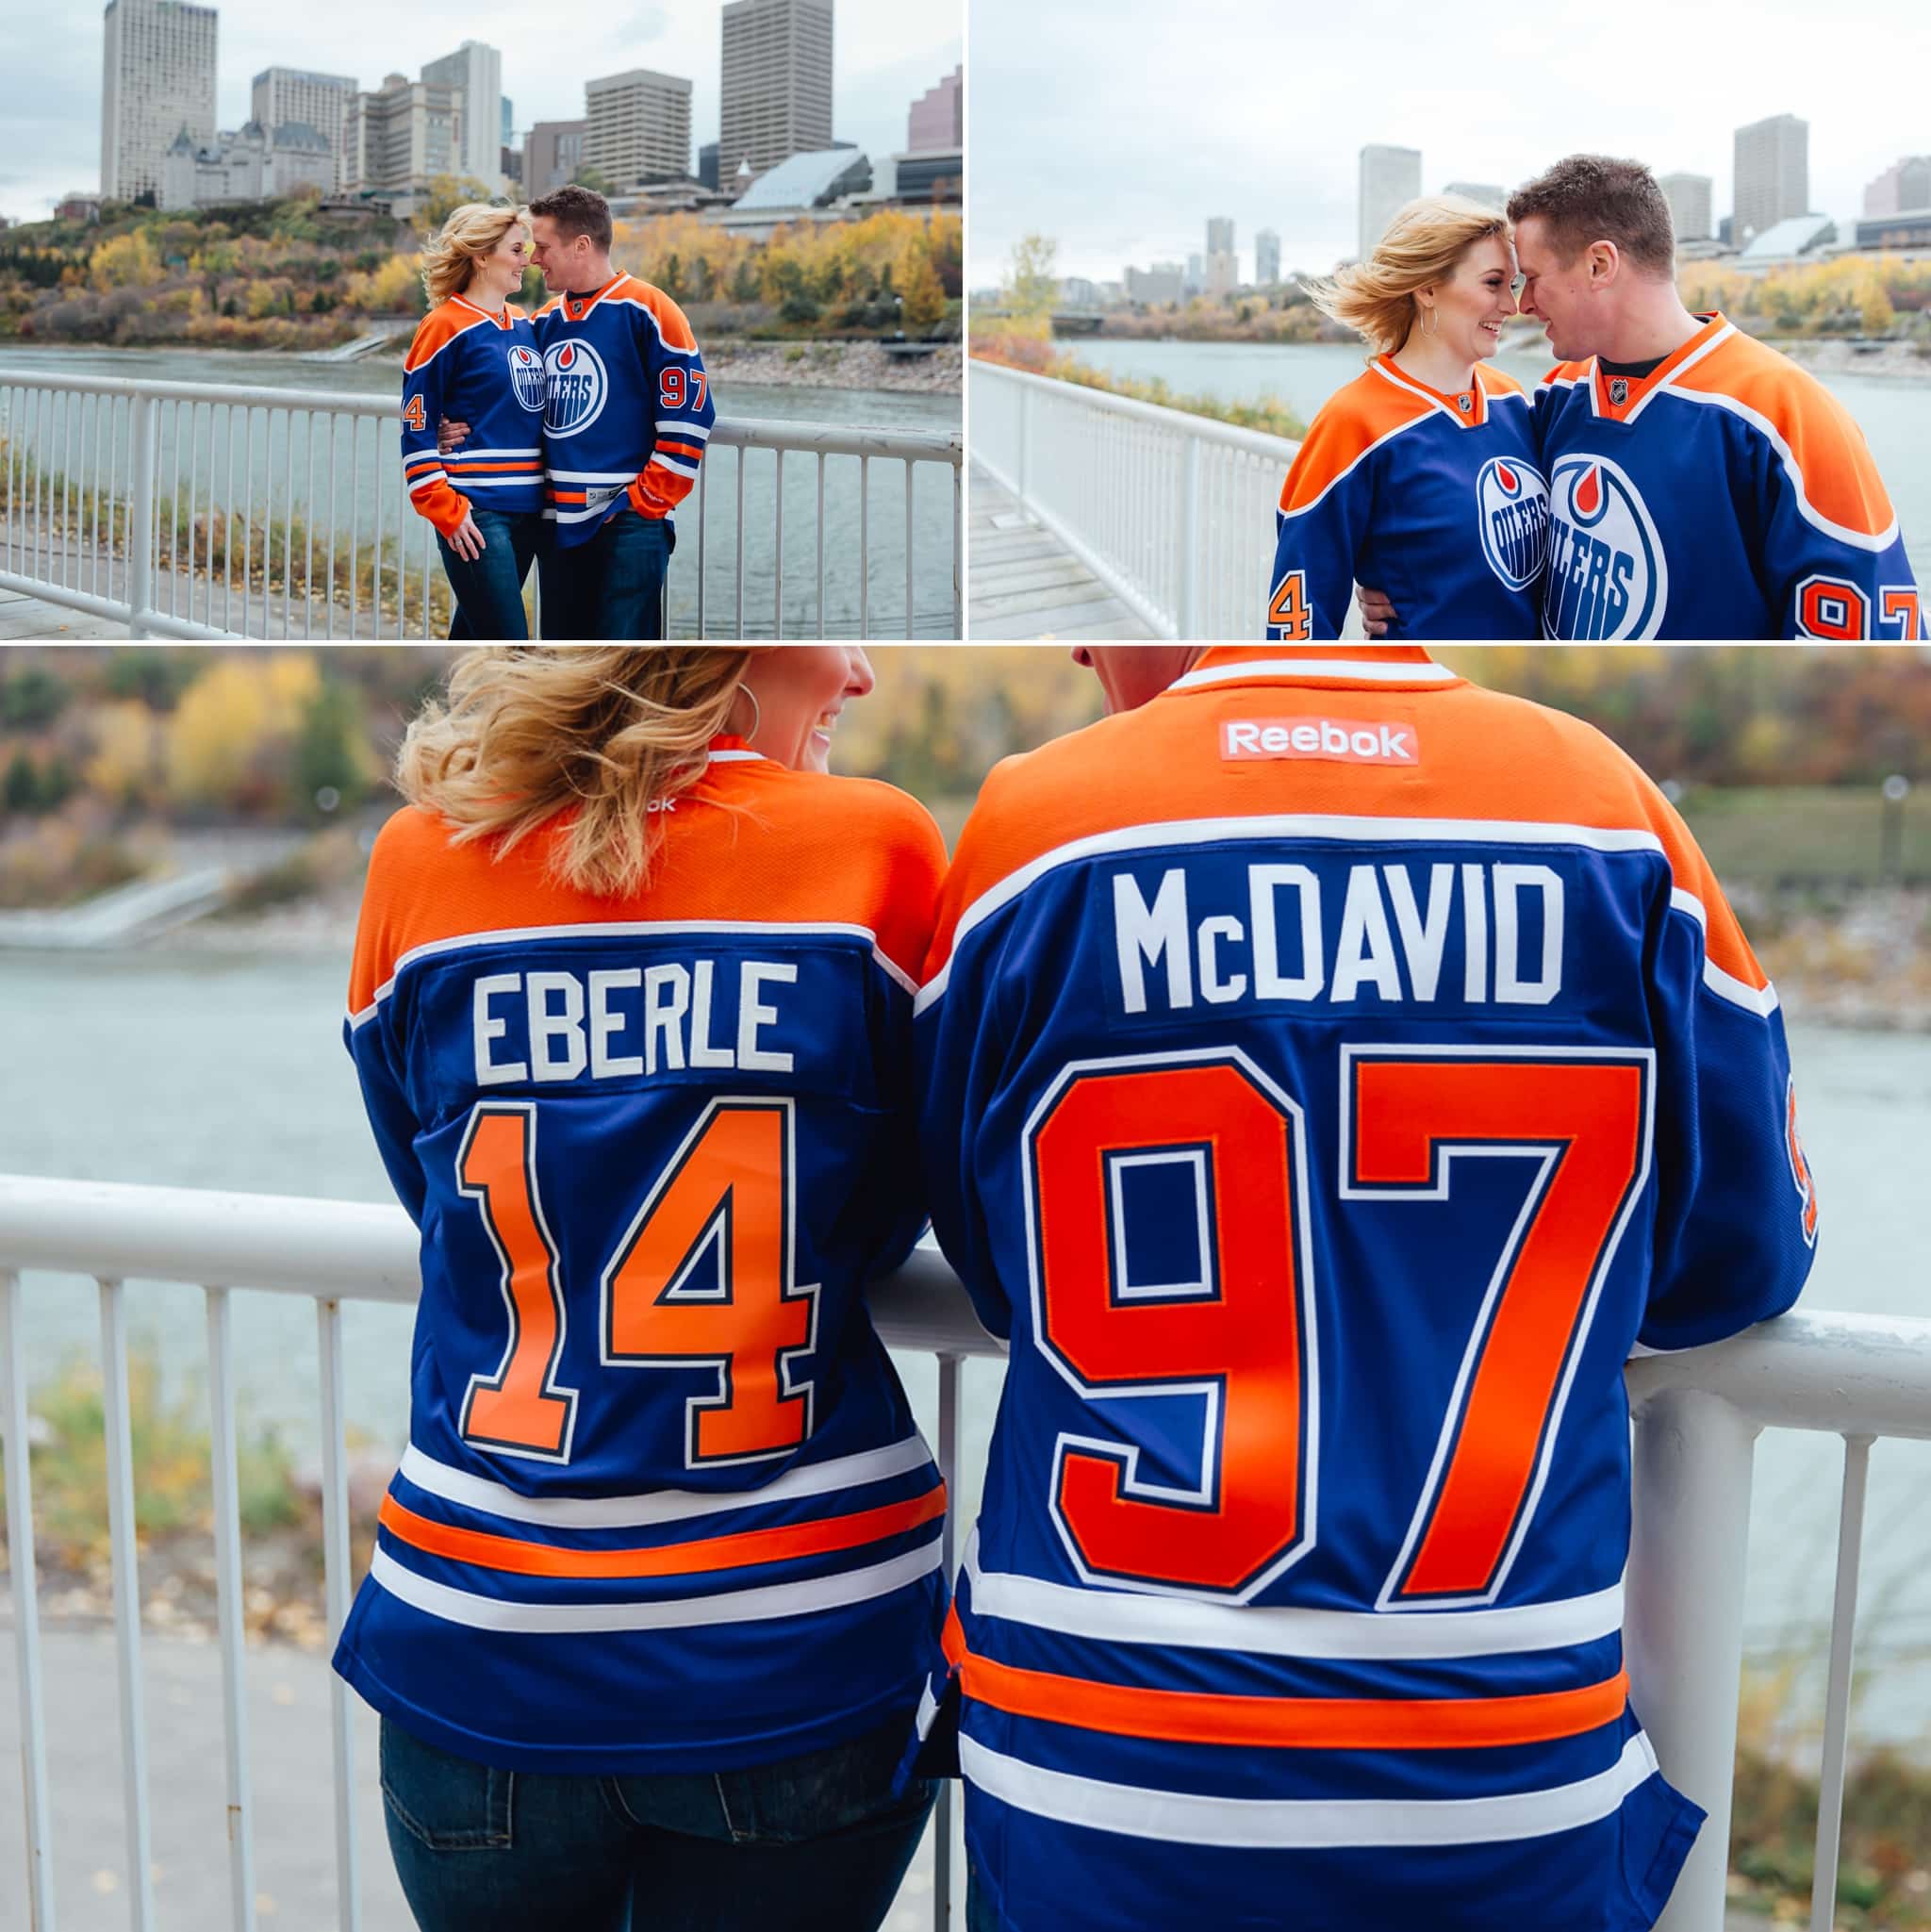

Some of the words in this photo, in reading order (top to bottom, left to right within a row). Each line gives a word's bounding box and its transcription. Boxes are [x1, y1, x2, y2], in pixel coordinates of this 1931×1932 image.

[402, 393, 427, 431] 4
[659, 366, 707, 412] 97
[1267, 570, 1312, 640] 4
[1795, 573, 1921, 640] 97
[1228, 720, 1411, 758] Reebok
[1113, 862, 1564, 1014] McDAVID
[475, 960, 798, 1086] EBERLE
[454, 1096, 821, 1470] 14
[1021, 1043, 1656, 1611] 97
